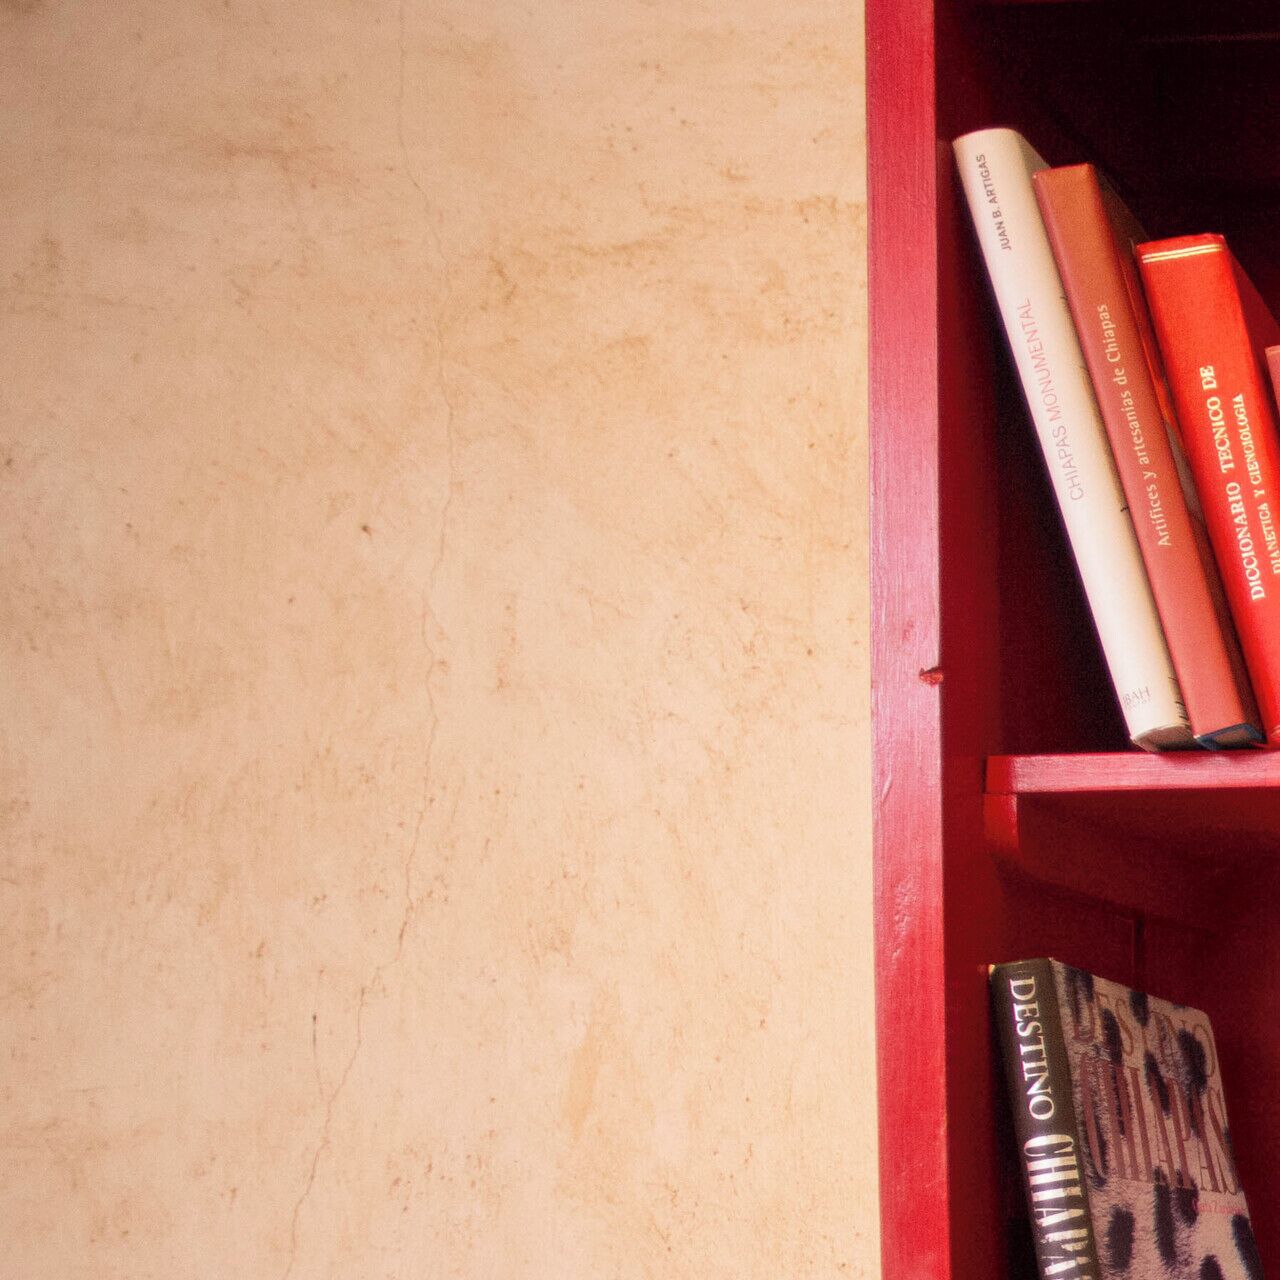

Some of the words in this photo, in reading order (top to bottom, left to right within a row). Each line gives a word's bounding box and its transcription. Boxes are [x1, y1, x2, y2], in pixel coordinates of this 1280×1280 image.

[976, 154, 998, 205] ARTIGAS
[992, 206, 1002, 218] B.
[995, 220, 1012, 251] JUAN
[1017, 298, 1062, 422] MONUMENTAL
[1097, 304, 1121, 363] Chiapas
[1113, 367, 1127, 386] de
[1200, 364, 1216, 390] DE
[1121, 390, 1150, 465] artesanías
[1206, 396, 1235, 473] TECNICO
[1232, 393, 1262, 486] CIENCIOLOGIA
[1052, 425, 1084, 501] CHIAPAS
[1143, 470, 1157, 480] y
[1253, 488, 1265, 499] Y
[1145, 483, 1171, 547] Artífices
[1226, 481, 1265, 601] DICCIONARIO
[1009, 976, 1055, 1121] DESTINO
